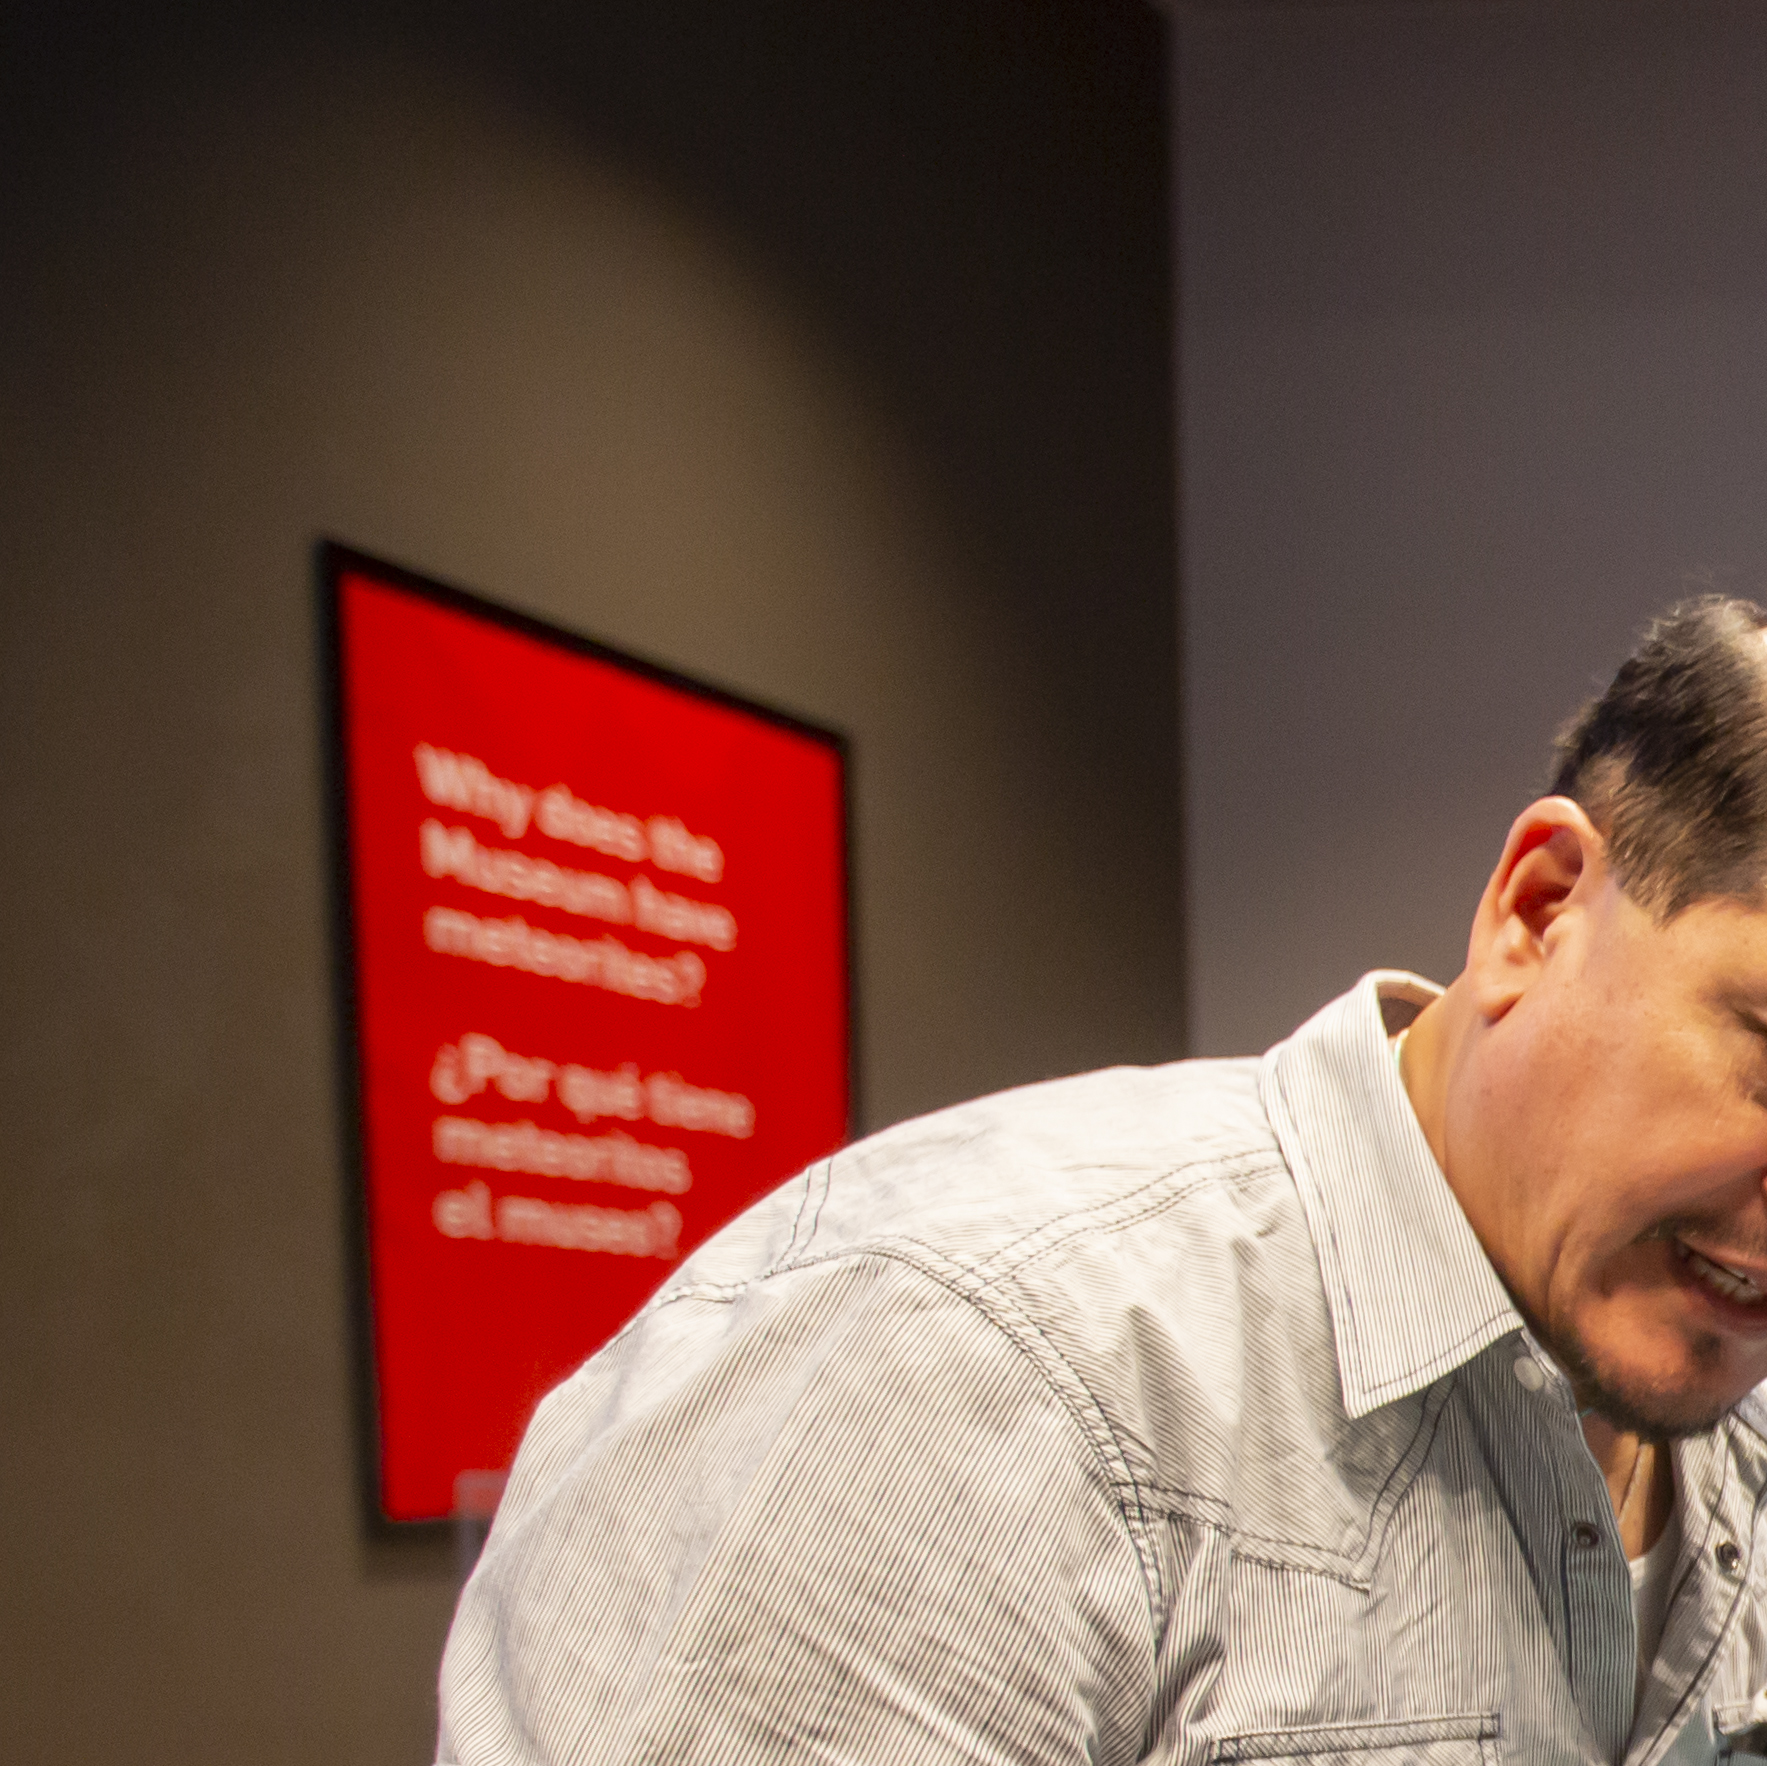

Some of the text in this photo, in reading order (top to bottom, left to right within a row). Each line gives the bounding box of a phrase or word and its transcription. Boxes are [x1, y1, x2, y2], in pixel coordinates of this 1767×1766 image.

[414, 742, 724, 882] Why does the
[420, 819, 737, 951] Museum have
[432, 1179, 493, 1239] el
